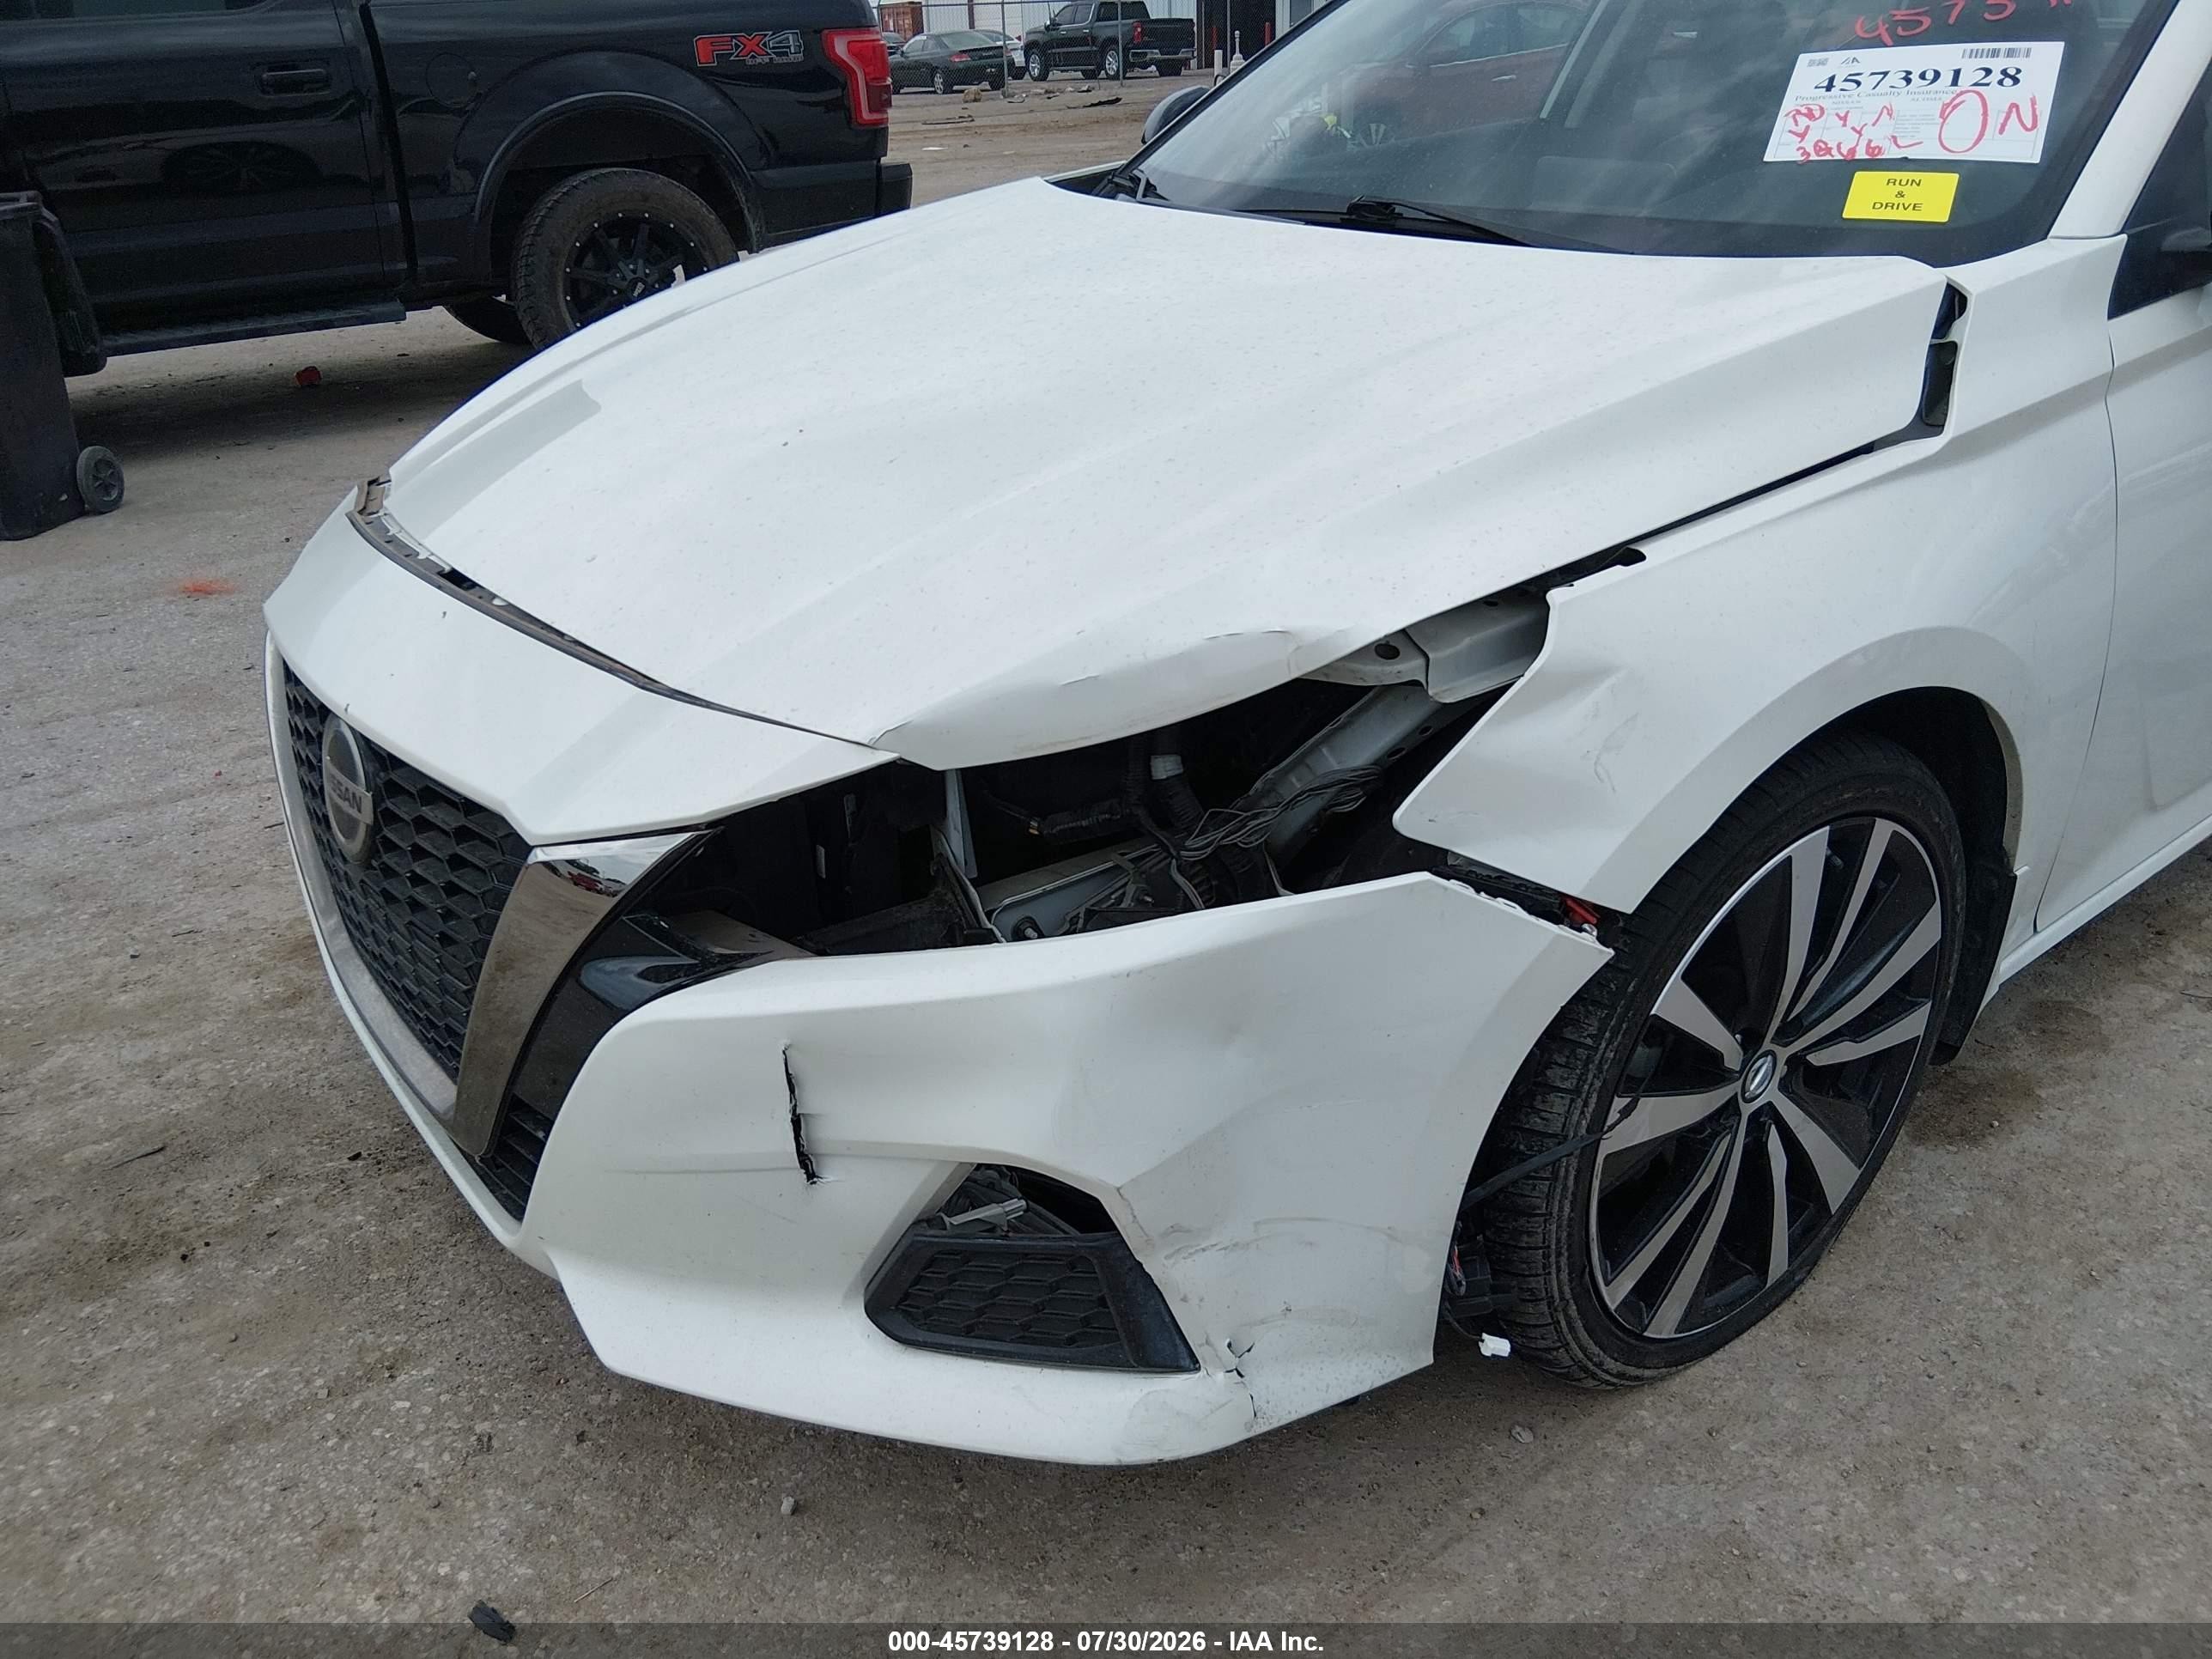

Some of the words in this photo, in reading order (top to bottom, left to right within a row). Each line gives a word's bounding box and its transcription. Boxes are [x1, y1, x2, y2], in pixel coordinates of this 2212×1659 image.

[694, 30, 804, 66] FX4
[1814, 66, 2023, 93] 45739128
[1795, 93, 1856, 101] Progressive
[1886, 178, 1922, 187] RUN
[1895, 190, 1905, 199] &
[1872, 202, 1923, 212] DRIVE
